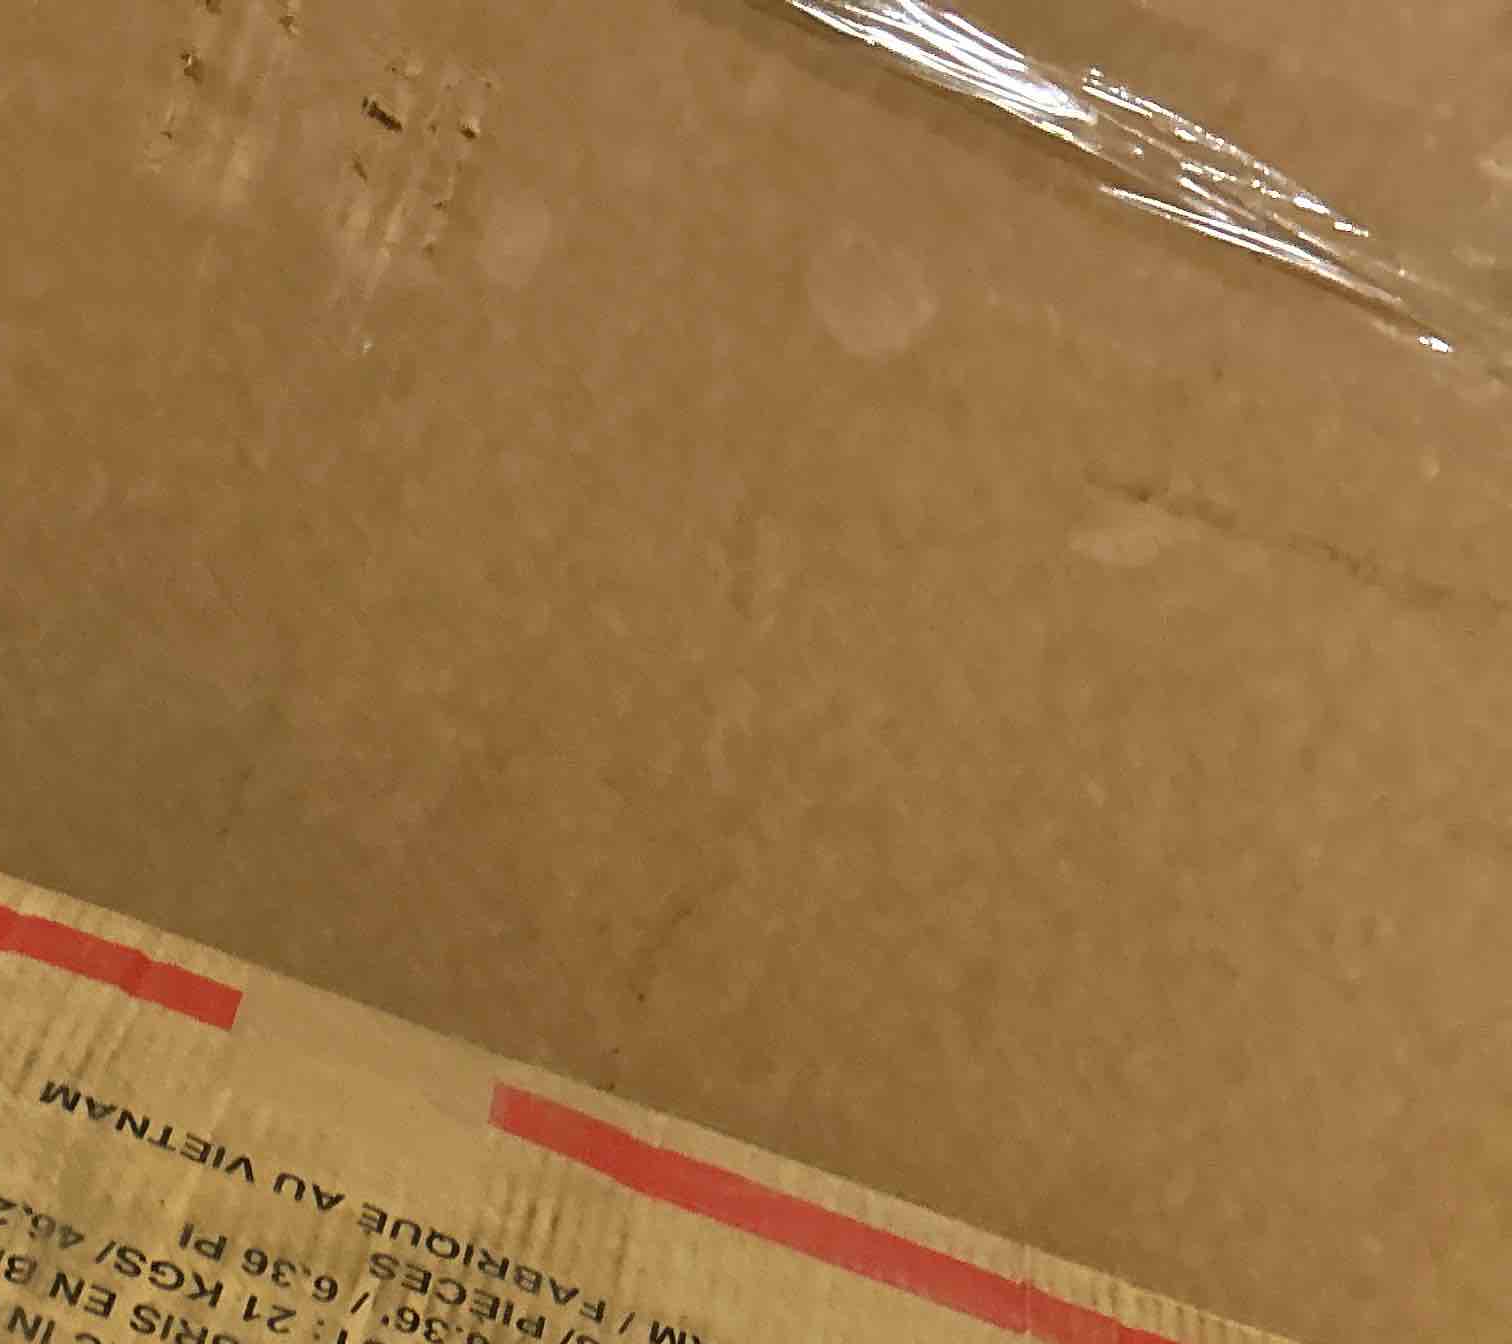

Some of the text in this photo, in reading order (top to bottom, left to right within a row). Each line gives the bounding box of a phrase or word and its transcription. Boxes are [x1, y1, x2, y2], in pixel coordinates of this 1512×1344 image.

[38, 1079, 255, 1184] VIETNAM
[272, 1171, 345, 1212] AU
[177, 1221, 229, 1263] PI
[356, 1201, 607, 1325] FABRIQUÉ
[47, 1270, 117, 1319] EN
[93, 1239, 224, 1309] KGS/
[240, 1246, 339, 1303] 6.36
[368, 1251, 546, 1340] PIÈCES
[241, 1293, 297, 1334] 21
[348, 1290, 370, 1315] /
[617, 1310, 636, 1336] /
